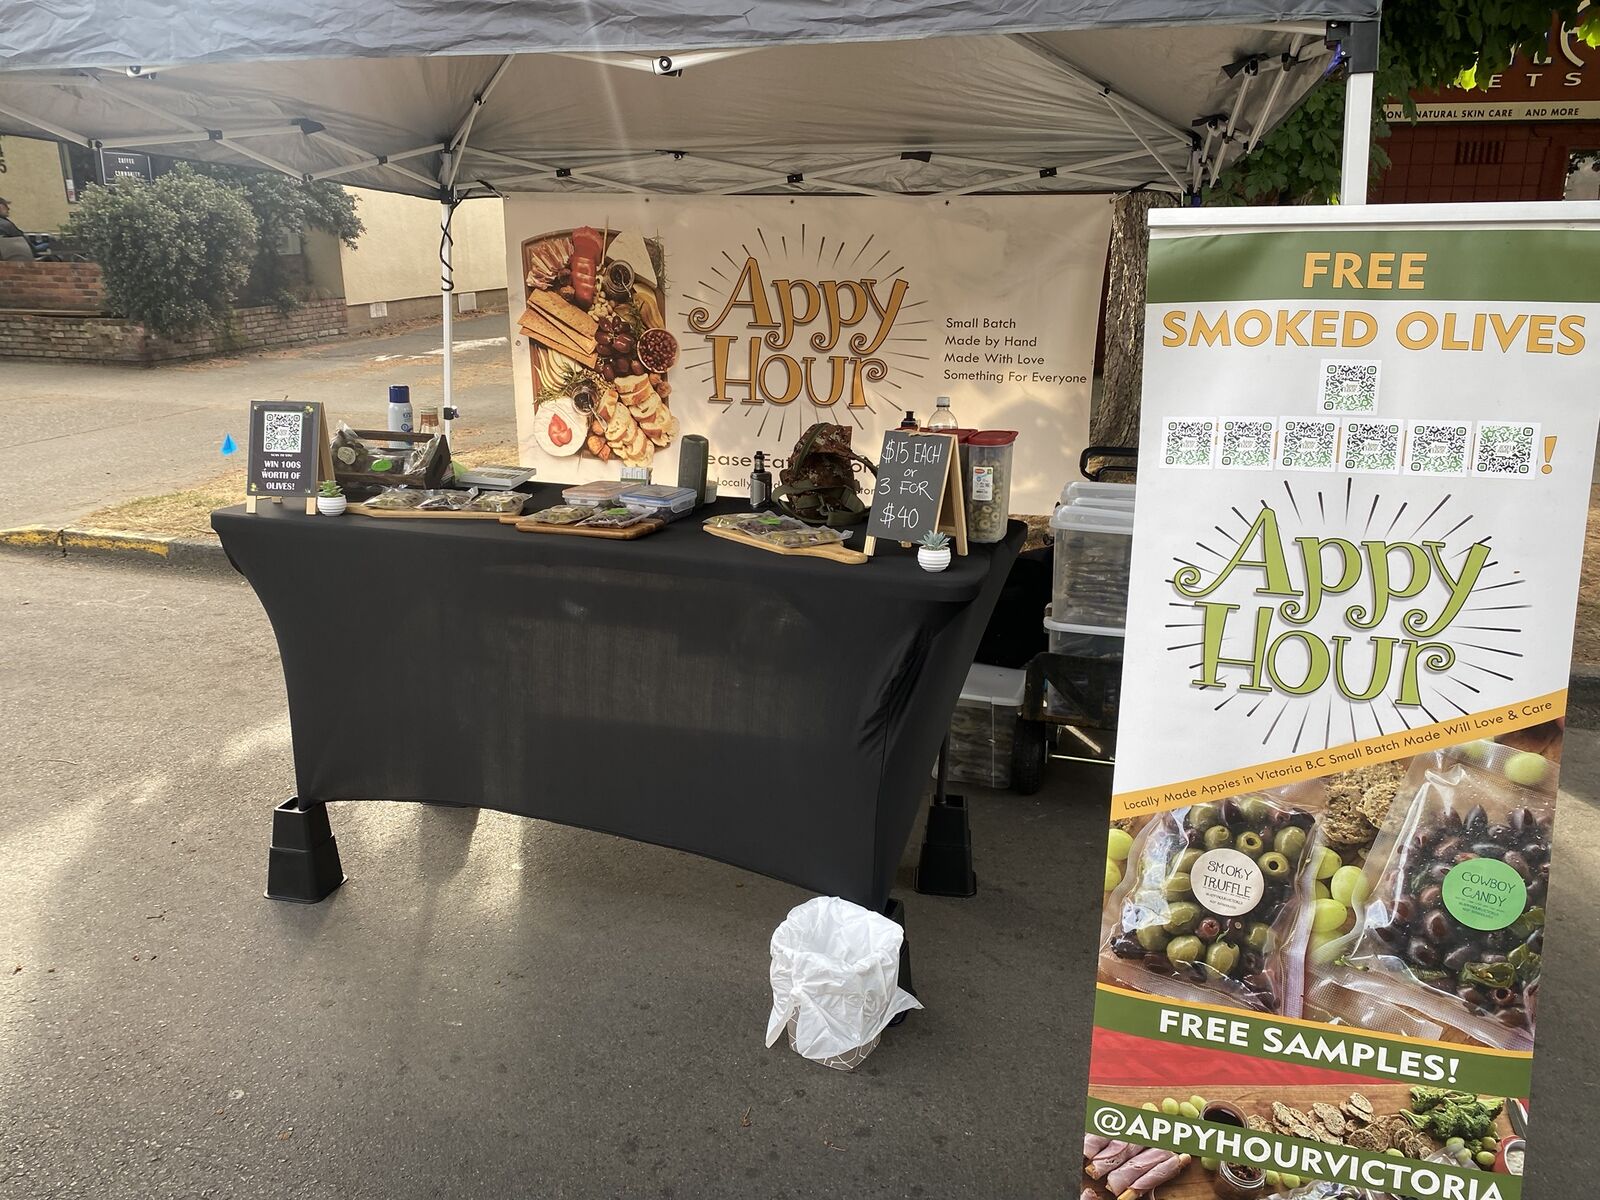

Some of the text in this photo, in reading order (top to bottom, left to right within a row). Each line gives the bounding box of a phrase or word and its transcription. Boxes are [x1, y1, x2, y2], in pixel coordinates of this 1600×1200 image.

[1461, 109, 1488, 118] SKIN
[1488, 109, 1513, 118] CARE
[1525, 108, 1547, 117] AND
[1550, 107, 1580, 116] MORE
[1302, 250, 1428, 290] FREE
[688, 256, 909, 355] Appy
[946, 317, 1016, 329] Small Batch
[1162, 309, 1586, 356] SMOKED OLIVES
[944, 335, 1037, 348] Made by Hand
[944, 353, 1045, 365] Made With Love
[943, 370, 1087, 385] Something For Everyone
[707, 454, 752, 467] ease
[881, 438, 943, 465] $15 EACH
[264, 460, 279, 468] WIN
[903, 467, 918, 478] or
[261, 471, 301, 479] WORTH OF
[717, 477, 751, 490] Locally
[266, 482, 295, 490] OLIVES!
[878, 477, 891, 495] 3
[899, 480, 934, 501] FOR
[879, 502, 919, 529] $40
[1174, 507, 1492, 637] Appy
[1124, 701, 1553, 811] Locally Made Appies in Victoria B.C Small Batch Made Will Love & Care
[1207, 860, 1253, 881] SMOKY
[1203, 874, 1252, 898] TRUFFLE
[1461, 871, 1516, 894] COWBOY
[1461, 886, 1507, 907] CANDY
[1159, 1009, 1460, 1084] FREE SAMPLES!
[1093, 1106, 1504, 1200] @APPYHOURVICTORIA
